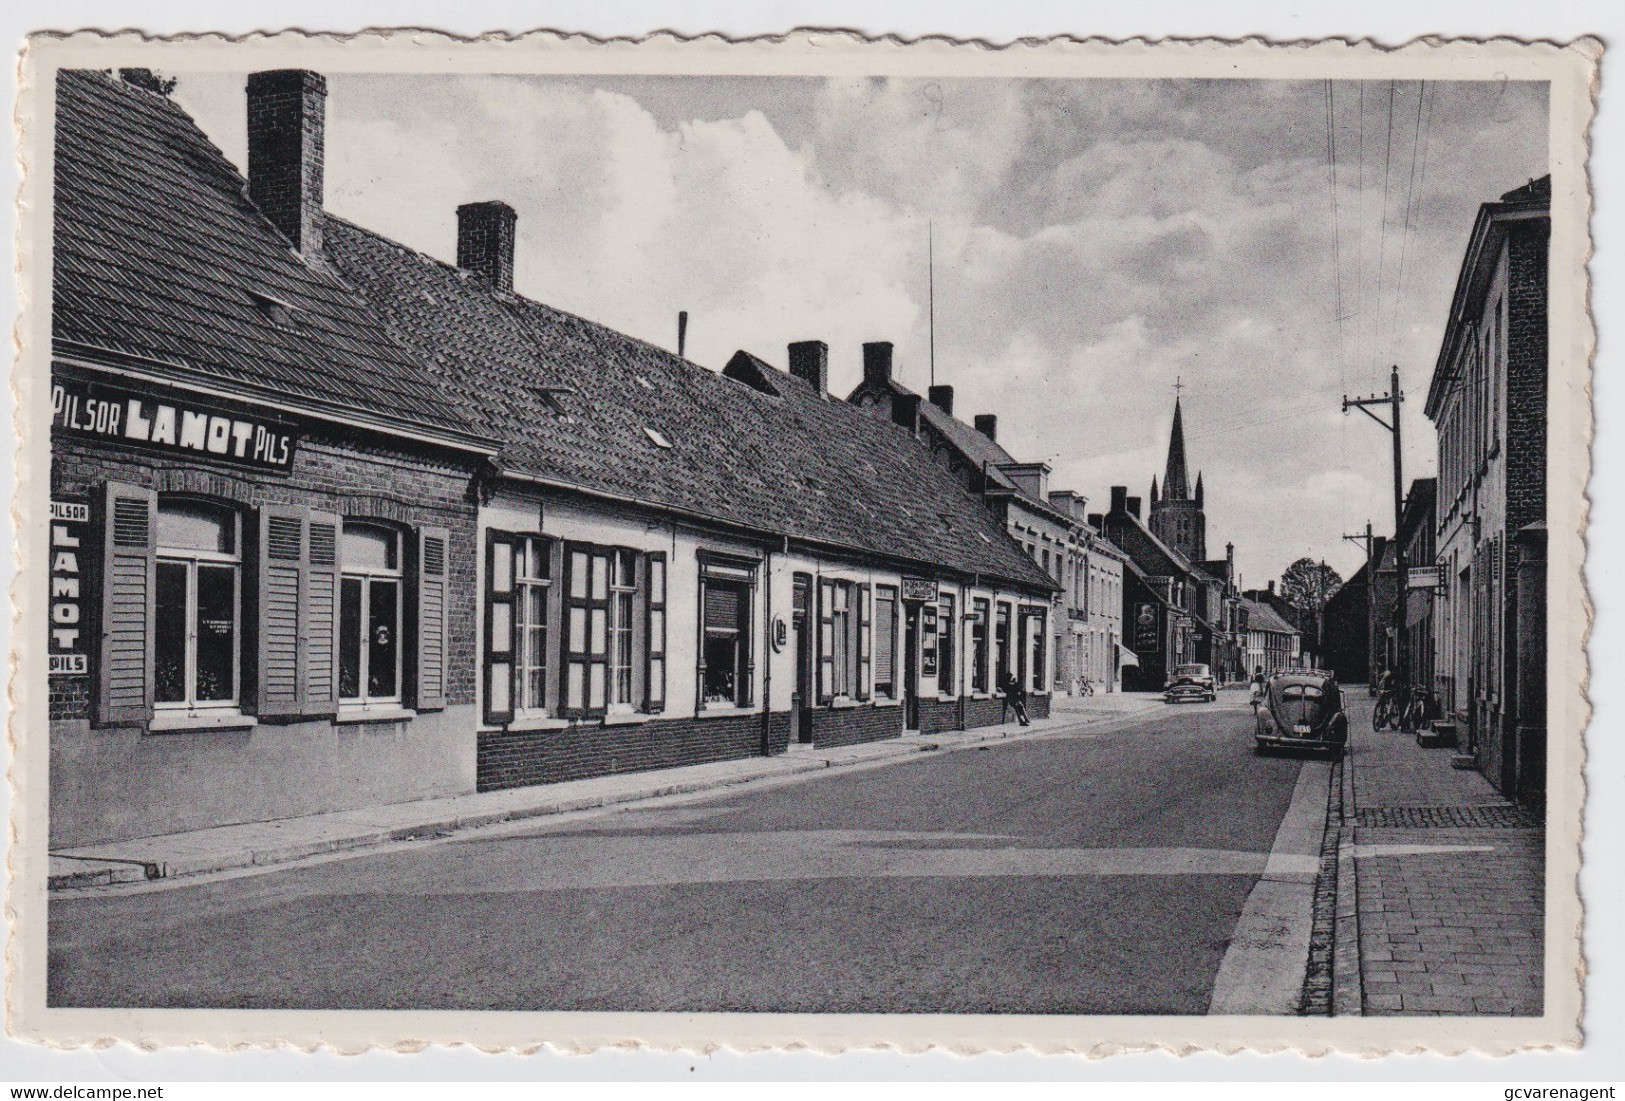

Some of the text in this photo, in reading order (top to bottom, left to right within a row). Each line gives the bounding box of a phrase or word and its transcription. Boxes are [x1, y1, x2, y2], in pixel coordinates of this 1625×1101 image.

[51, 385, 289, 464] PILSOR LAMOT PILS
[52, 525, 80, 648] LAMOT
[49, 656, 84, 670] PILS
